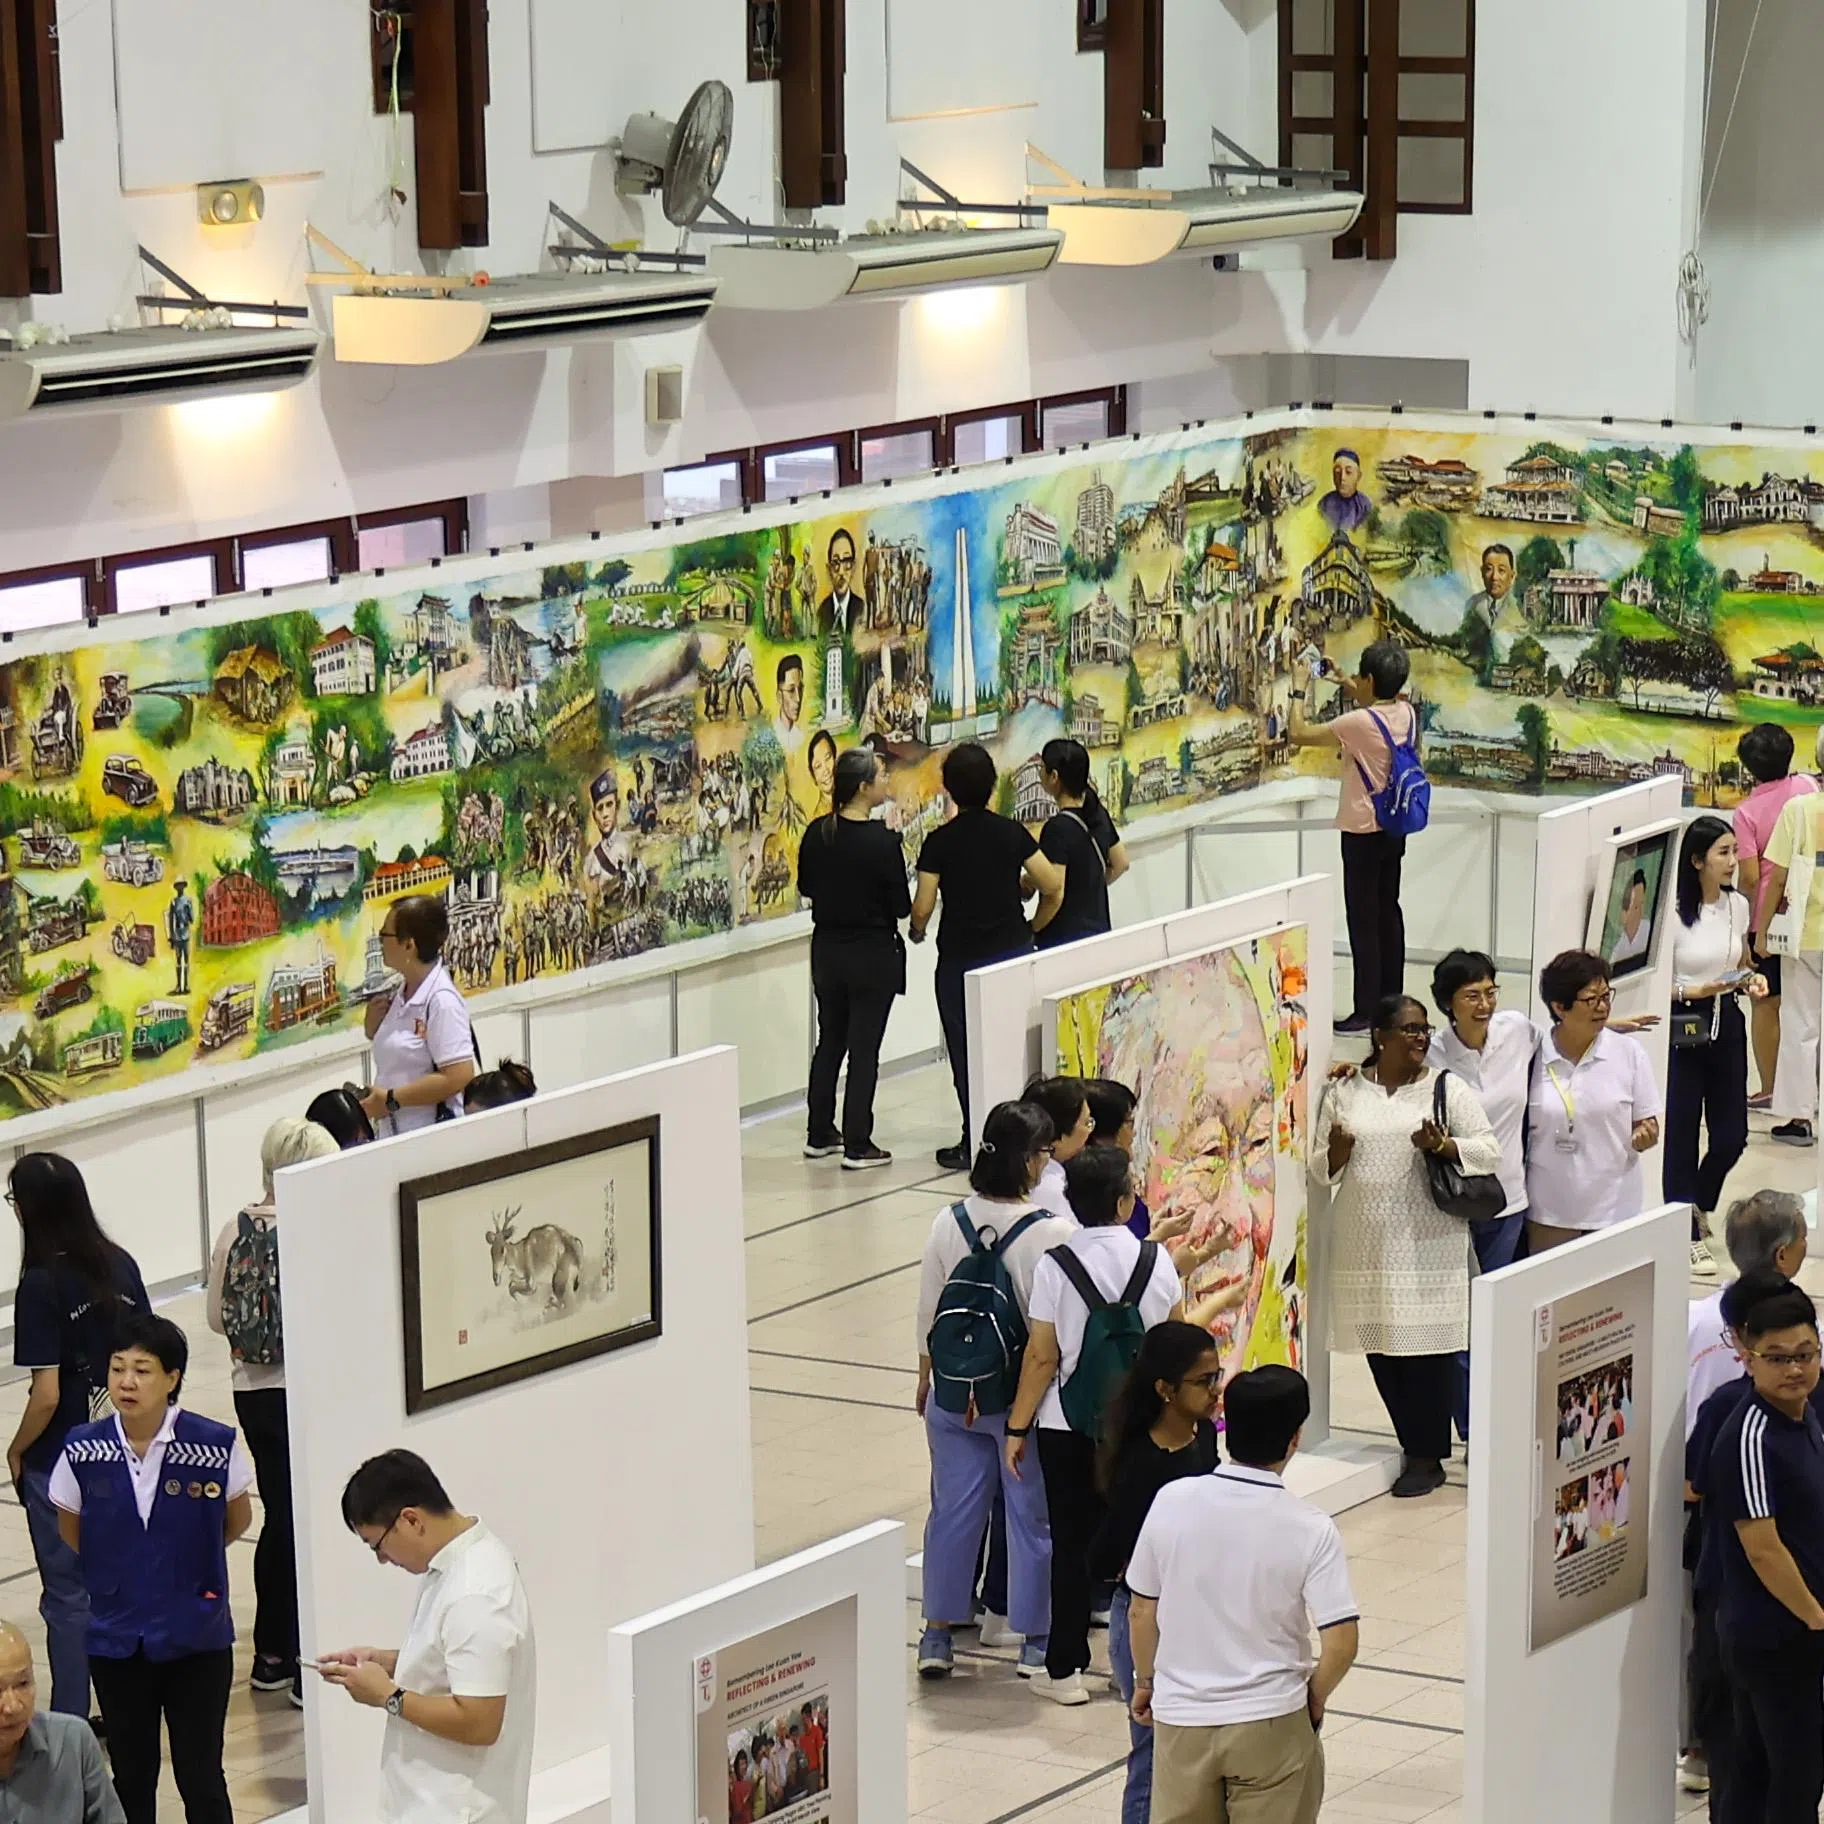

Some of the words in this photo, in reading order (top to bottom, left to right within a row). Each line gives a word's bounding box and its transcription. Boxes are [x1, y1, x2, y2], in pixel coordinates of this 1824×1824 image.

[726, 1675, 768, 1700] REFLECTING
[770, 1672, 775, 1682] &
[777, 1656, 815, 1679] RENEWING
